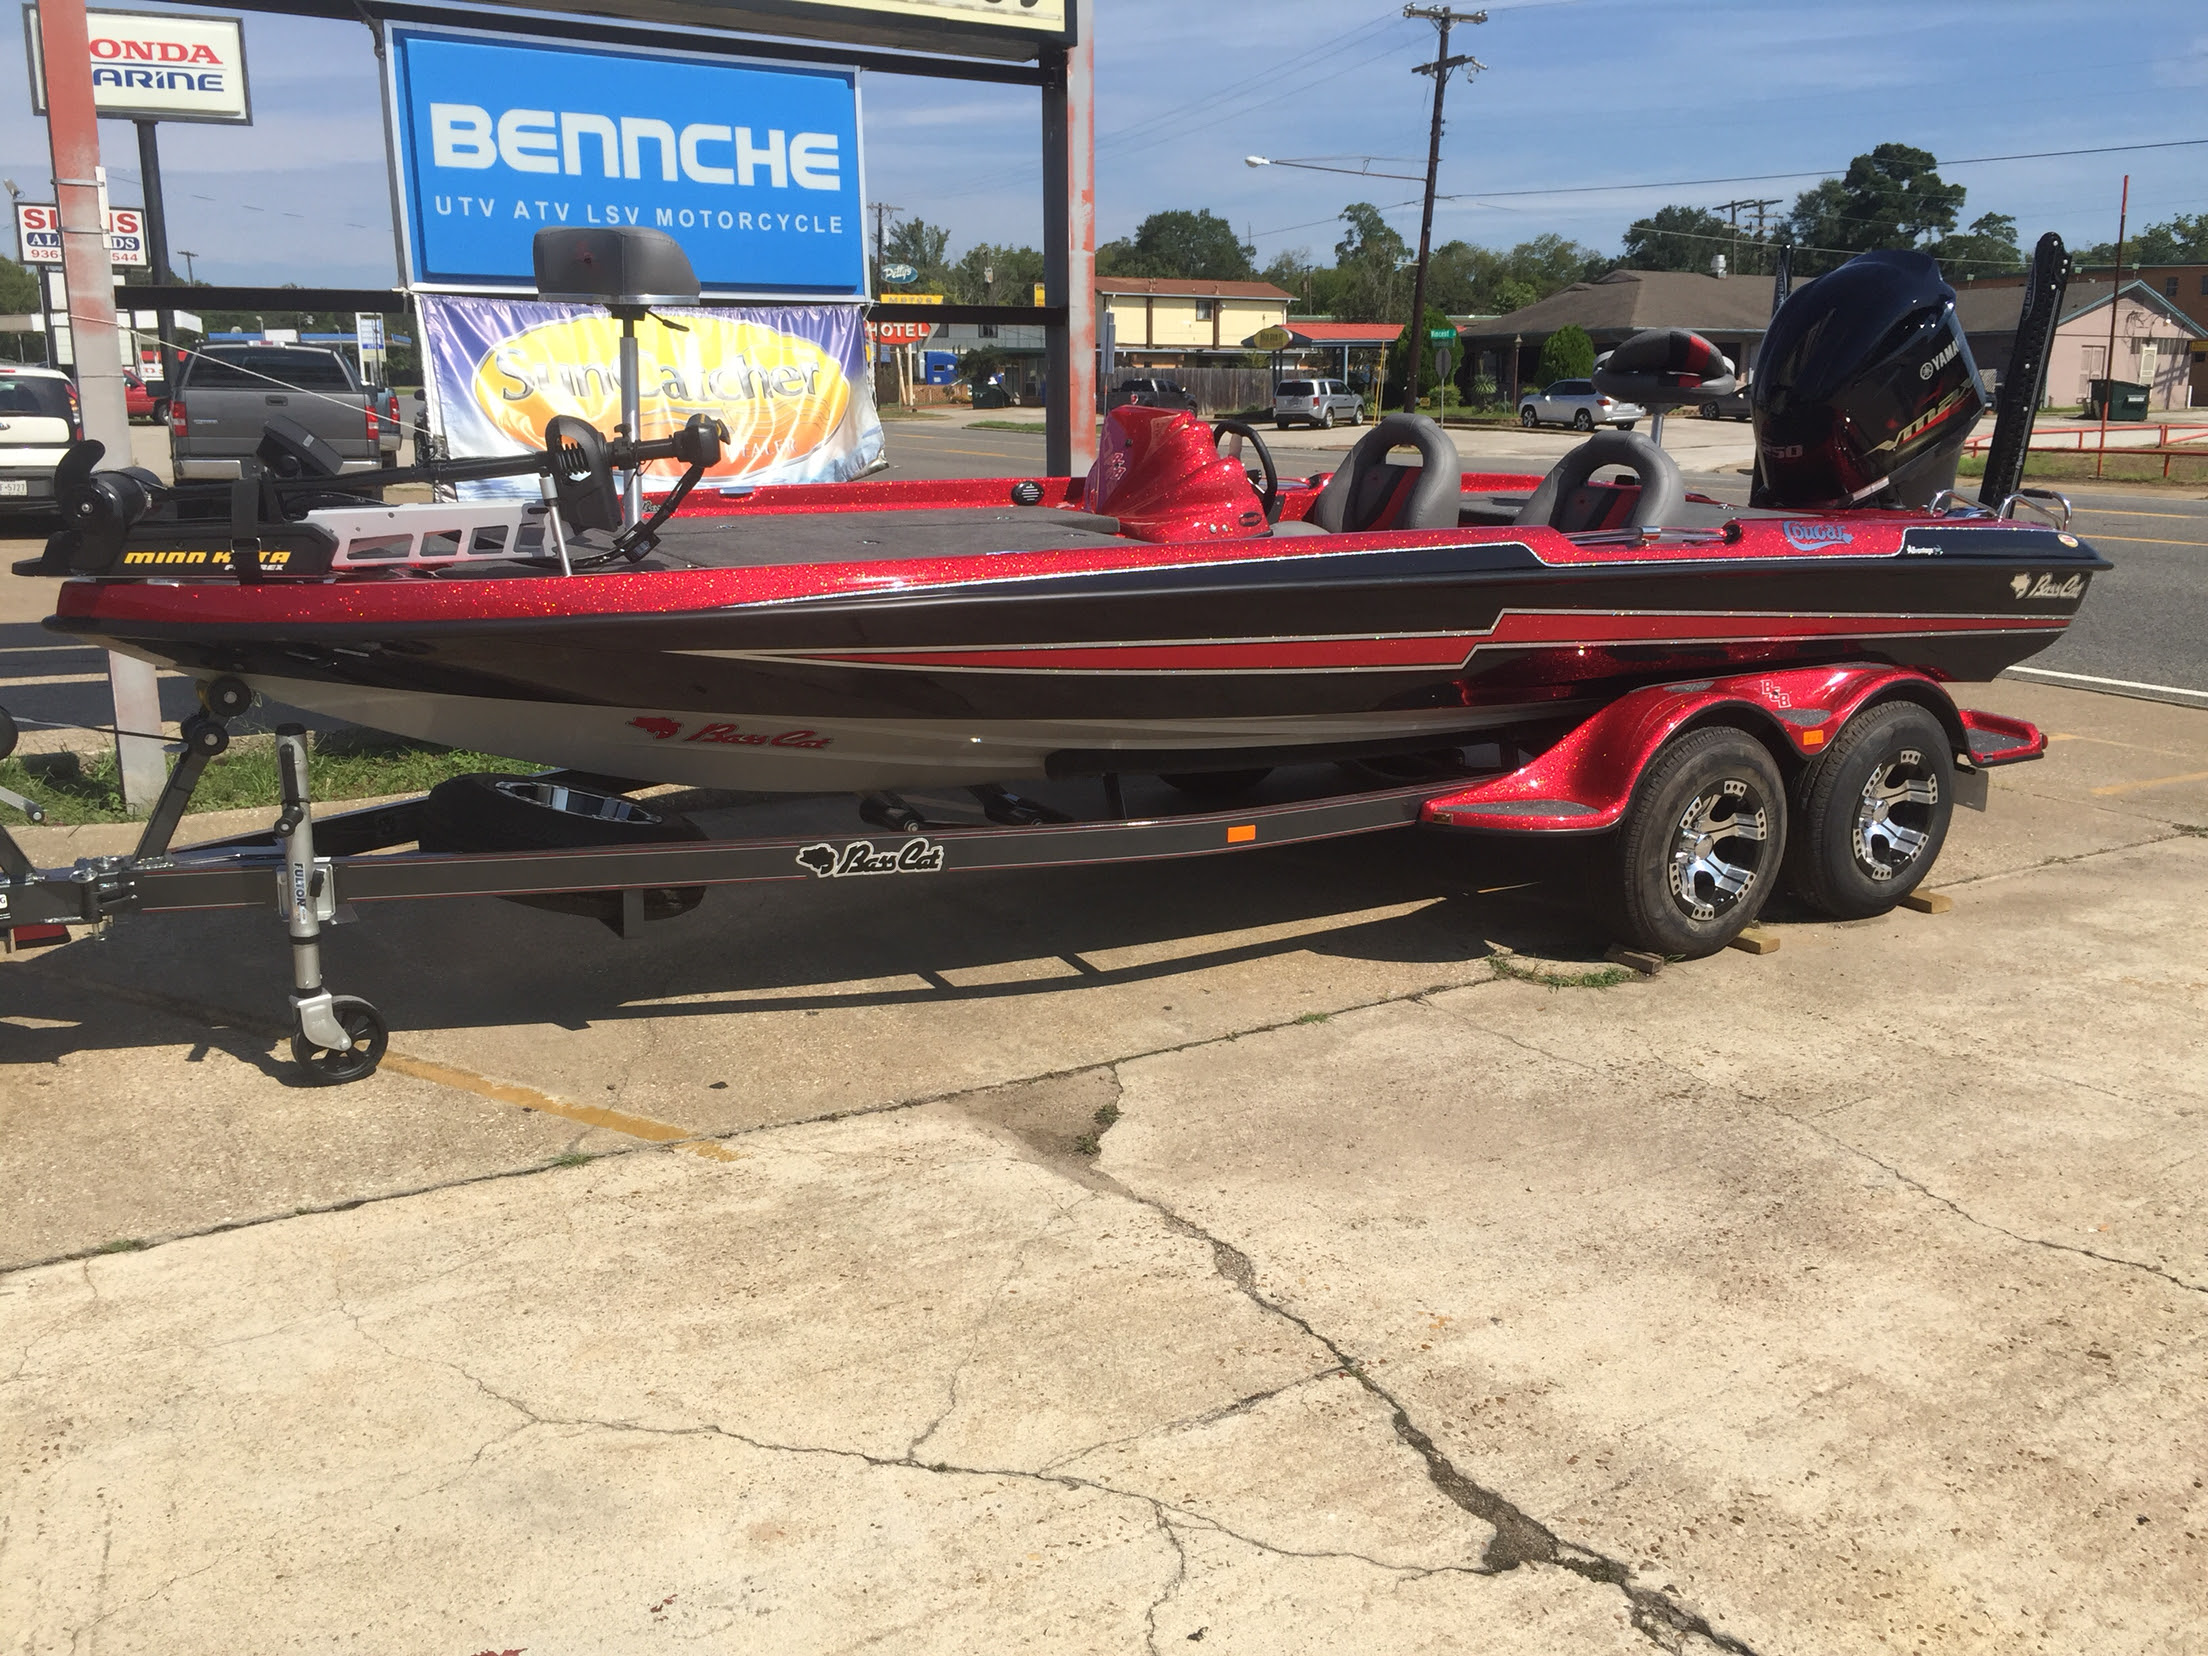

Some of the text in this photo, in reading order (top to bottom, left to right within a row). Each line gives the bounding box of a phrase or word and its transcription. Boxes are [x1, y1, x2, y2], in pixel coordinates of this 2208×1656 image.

[89, 38, 223, 65] ONDA
[92, 68, 225, 92] ARINE
[430, 102, 841, 191] BENNCHE
[435, 196, 843, 234] UTV ATV LSV MOTORCYCLE
[211, 551, 292, 564] KTA
[2026, 571, 2086, 599] Bass Cat
[684, 722, 833, 749] Bass Cat
[834, 838, 944, 877] Bass Cat
[293, 863, 306, 908] FULTON
